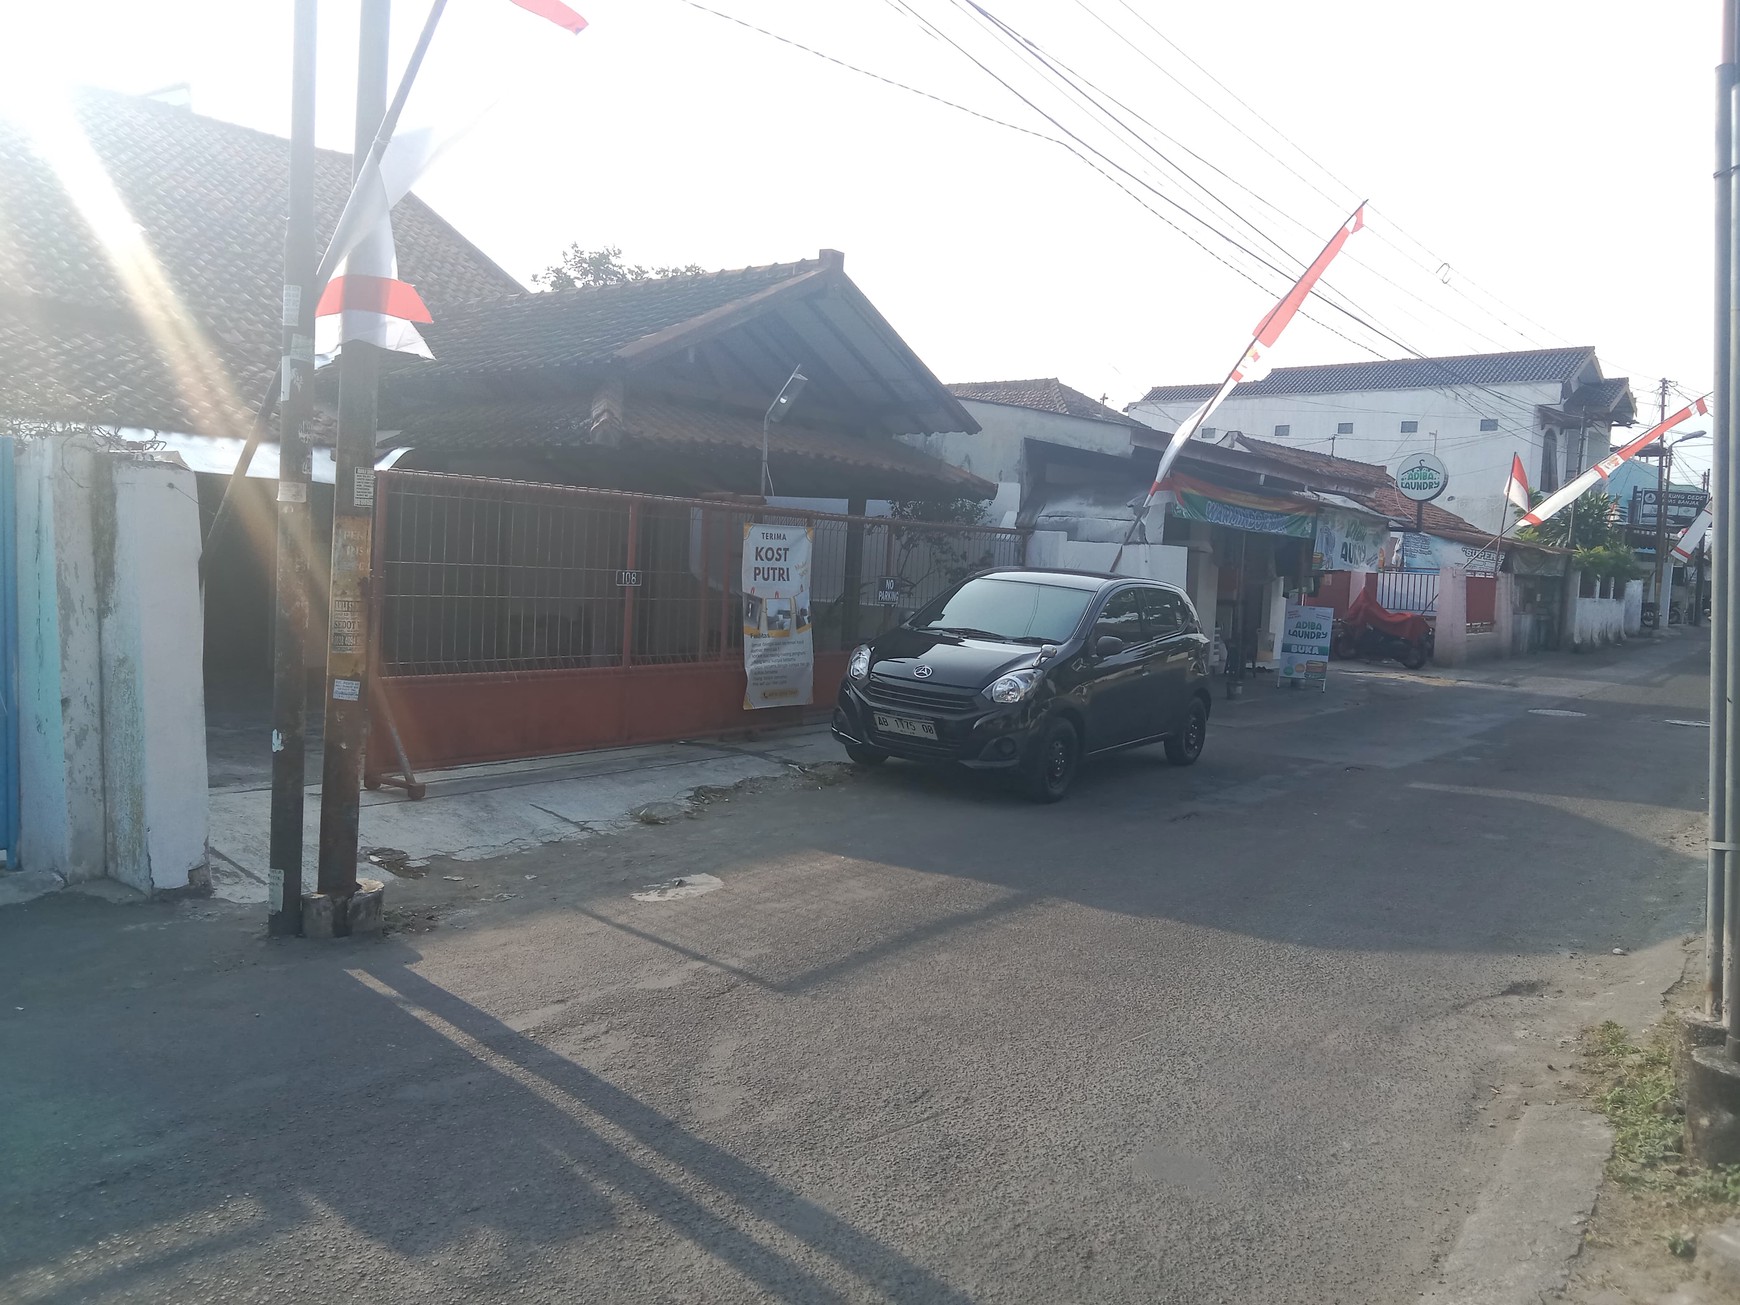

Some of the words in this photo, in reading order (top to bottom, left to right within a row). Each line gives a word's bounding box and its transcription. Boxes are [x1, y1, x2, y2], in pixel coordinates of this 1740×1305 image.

[1407, 472, 1434, 481] ADIBA
[1400, 481, 1440, 491] LAUNDRY
[761, 532, 787, 541] TERIMA
[754, 546, 790, 562] KOST
[753, 566, 790, 582] PUTRI
[885, 579, 895, 590] NO
[878, 590, 900, 602] PARKING
[1295, 621, 1322, 631] ADIBA
[1288, 629, 1328, 640] LAUNDRY
[1290, 644, 1319, 655] BUKA
[877, 716, 889, 727] AB
[894, 719, 916, 731] 1175
